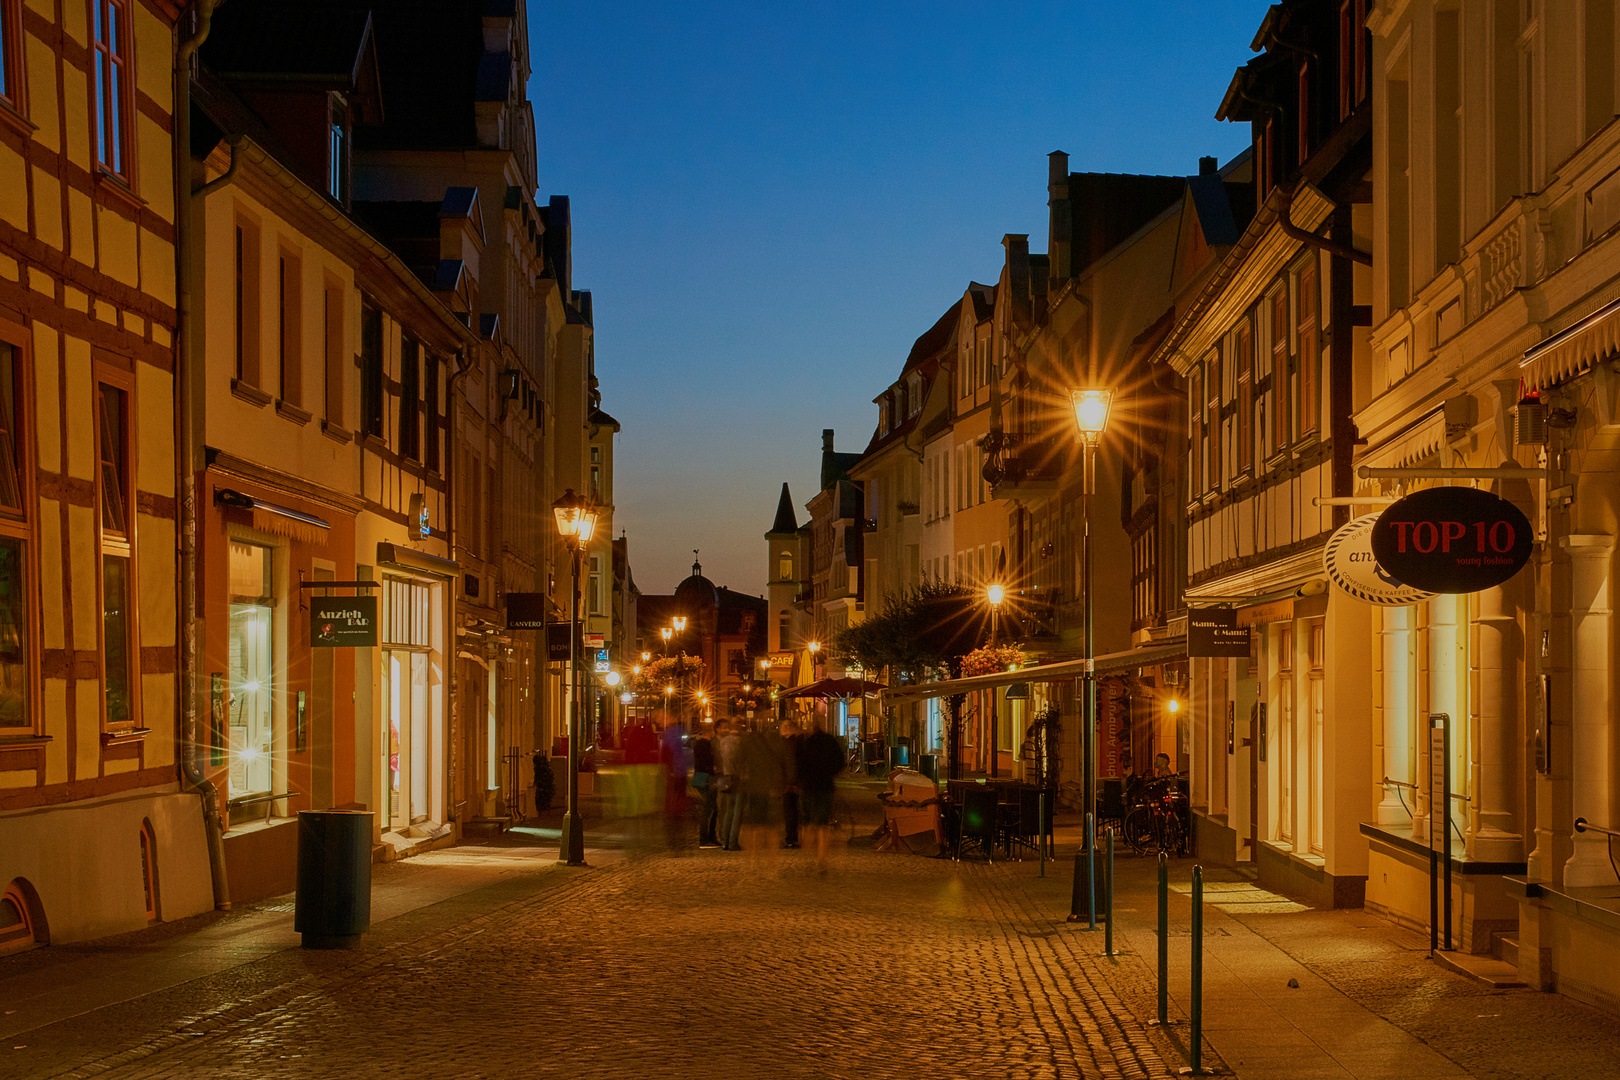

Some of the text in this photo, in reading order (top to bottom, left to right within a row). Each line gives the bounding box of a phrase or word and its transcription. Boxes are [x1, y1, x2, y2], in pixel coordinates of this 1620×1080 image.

[1351, 530, 1363, 540] DIE
[1389, 520, 1516, 553] TOP 10
[1348, 551, 1376, 563] an
[1456, 556, 1514, 567] young fashion
[1342, 571, 1377, 594] CONFISERIE
[317, 609, 362, 619] Anzieh
[347, 618, 369, 626] BAR
[770, 655, 794, 665] CAFÉ
[1106, 684, 1117, 746] Armbruster
